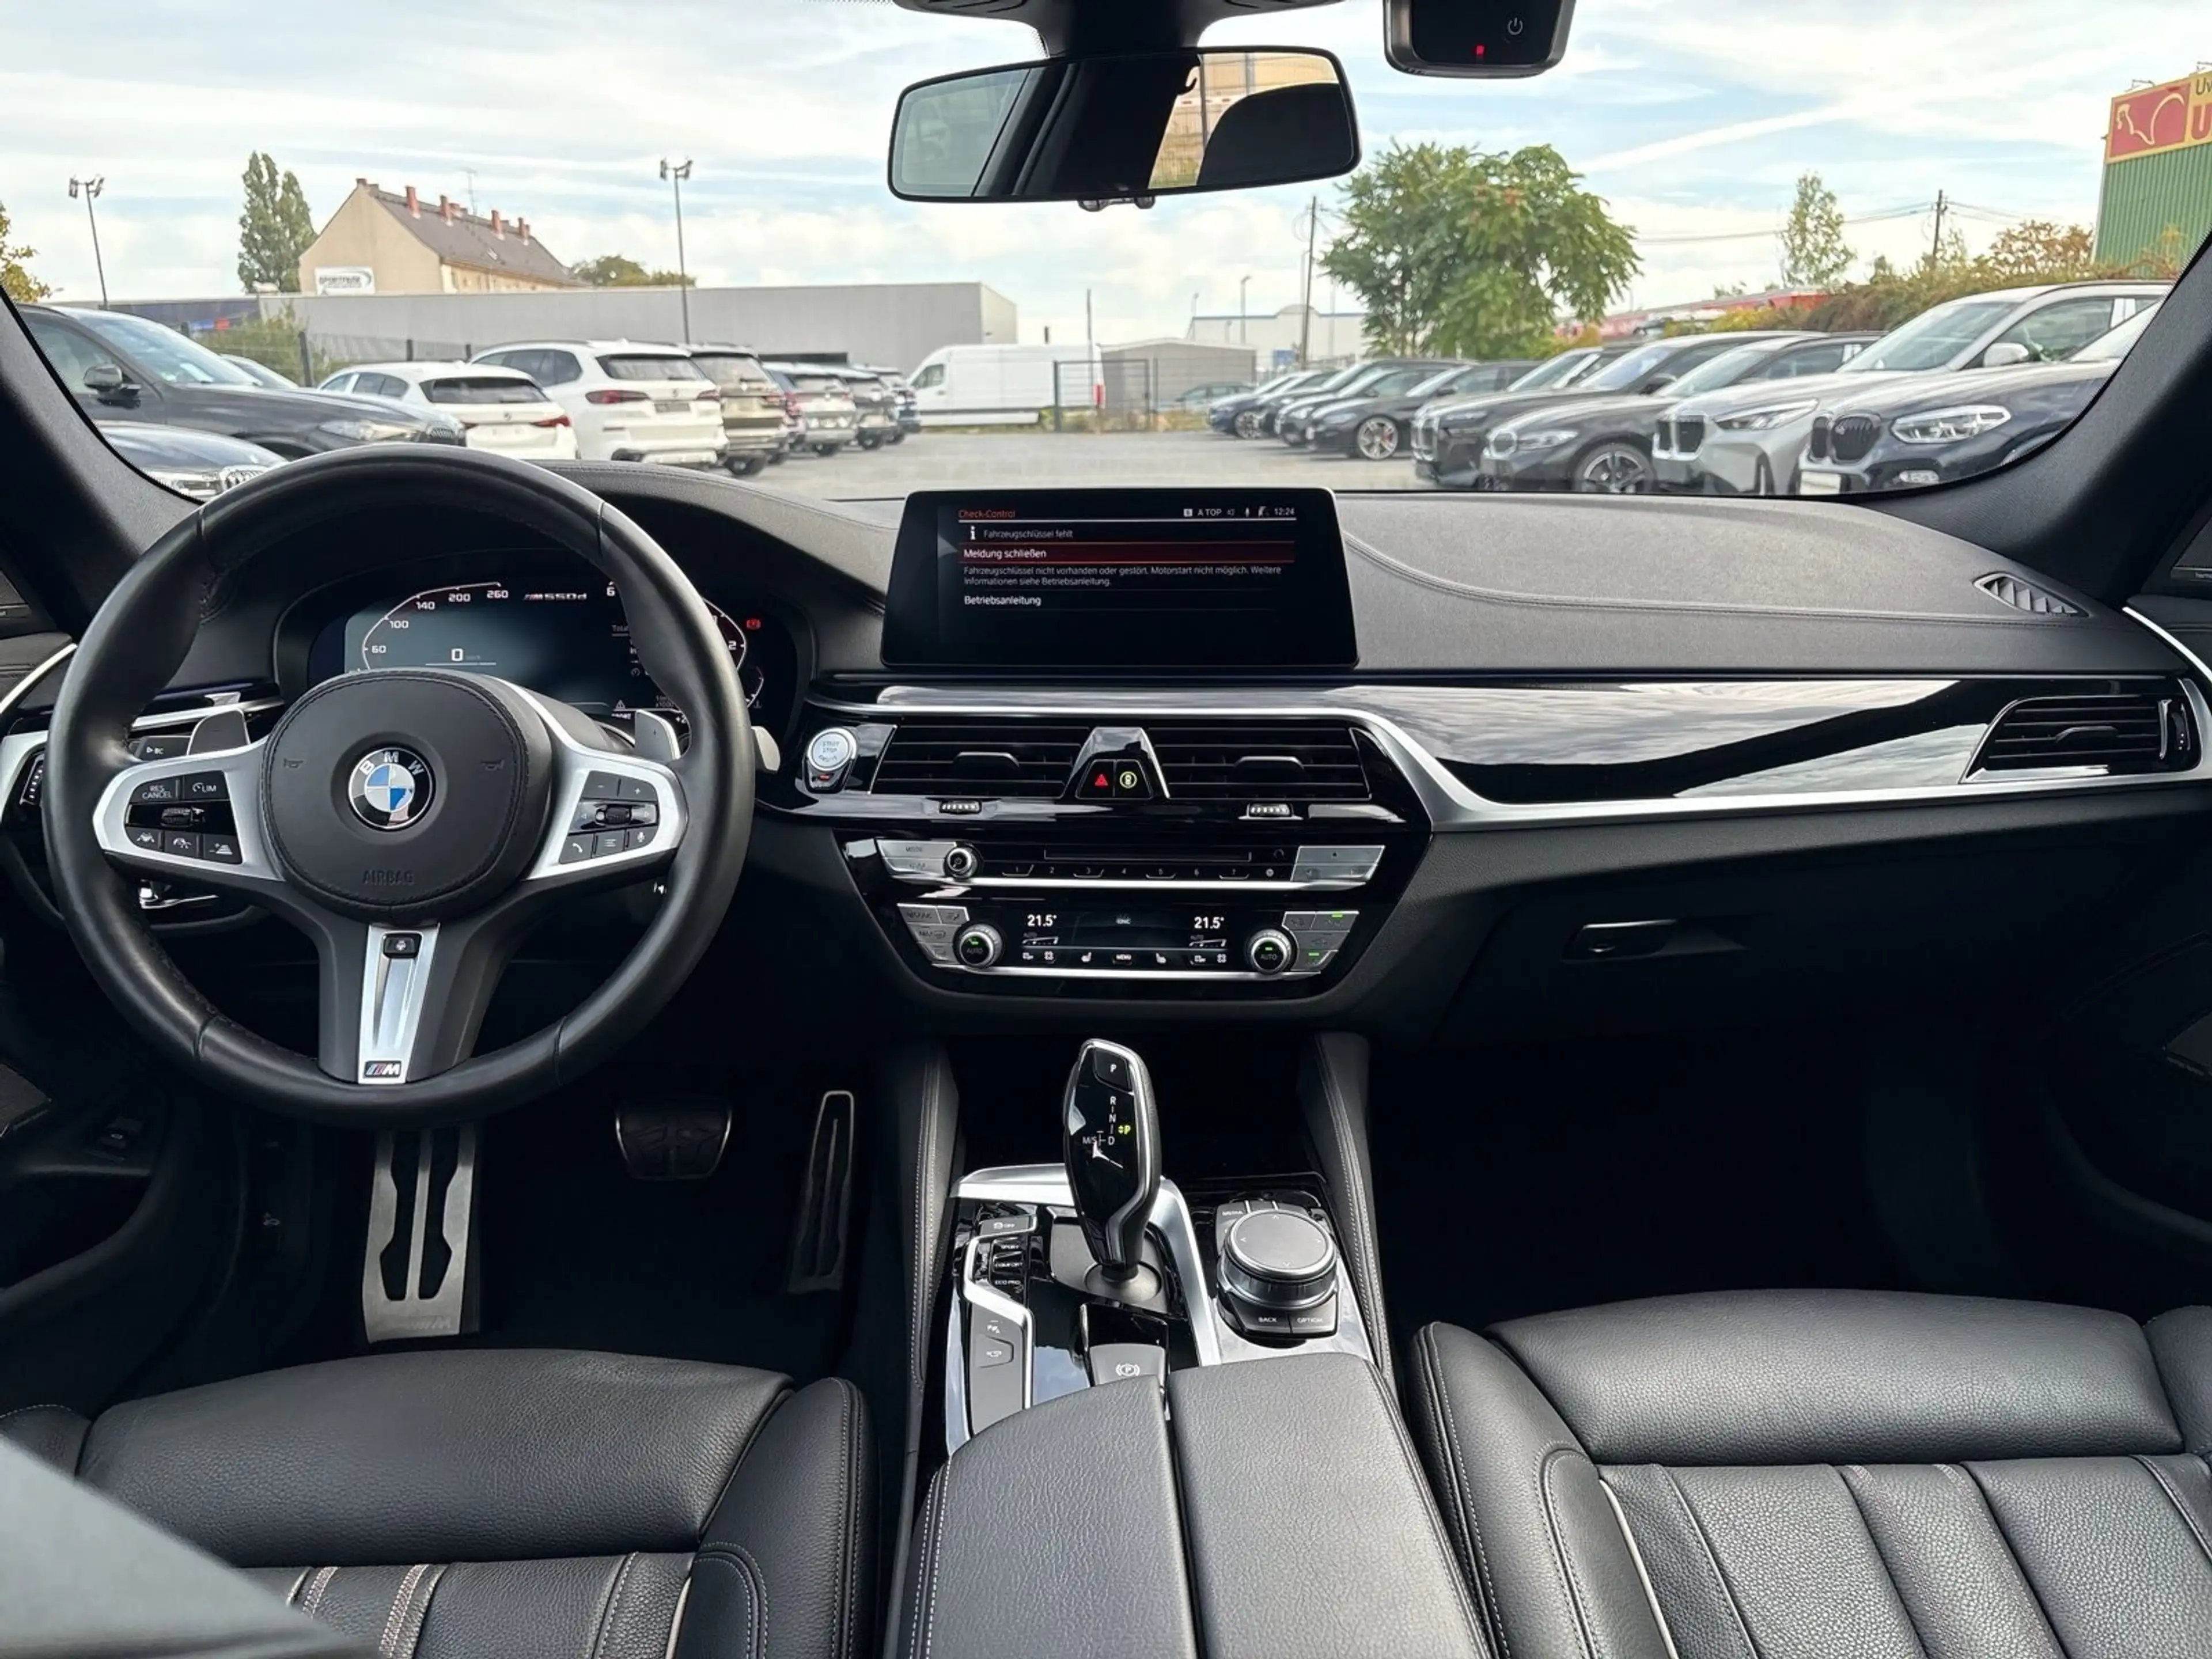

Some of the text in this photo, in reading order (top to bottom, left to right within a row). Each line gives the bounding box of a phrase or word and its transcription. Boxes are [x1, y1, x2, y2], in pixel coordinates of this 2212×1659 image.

[959, 510, 1016, 518] Check-Control
[1274, 507, 1295, 516] 12:24
[984, 529, 1073, 539] Fahrzeugschlüssel fehlt
[964, 549, 1046, 559] Meldung schließen
[964, 567, 1034, 576] Fahrzeugschlüssel
[1036, 566, 1054, 574] nicht
[1056, 566, 1097, 574] vorhanden
[1099, 566, 1117, 574] oder
[1151, 566, 1192, 574] Motorstart
[1194, 566, 1213, 574] nicht
[1215, 566, 1248, 575] möglich.
[1251, 566, 1282, 574] Weitere
[964, 577, 1111, 587] Informationen siehe Betriebsanleitung.
[487, 590, 509, 599] 260
[607, 586, 616, 597] 6
[449, 593, 471, 603] 200
[964, 596, 1041, 606] Betriebsanleitung
[416, 601, 435, 611] 140
[389, 620, 409, 629] 100
[372, 645, 387, 654] 60
[729, 641, 737, 650] 2
[452, 648, 463, 661] 0
[359, 751, 425, 776] BMW
[142, 791, 173, 800] CANCEL
[363, 869, 415, 885] AIRBAG
[1110, 1064, 1117, 1073] P
[1110, 1096, 1116, 1105] R
[1108, 1114, 1116, 1123] N
[1108, 1136, 1115, 1145] D
